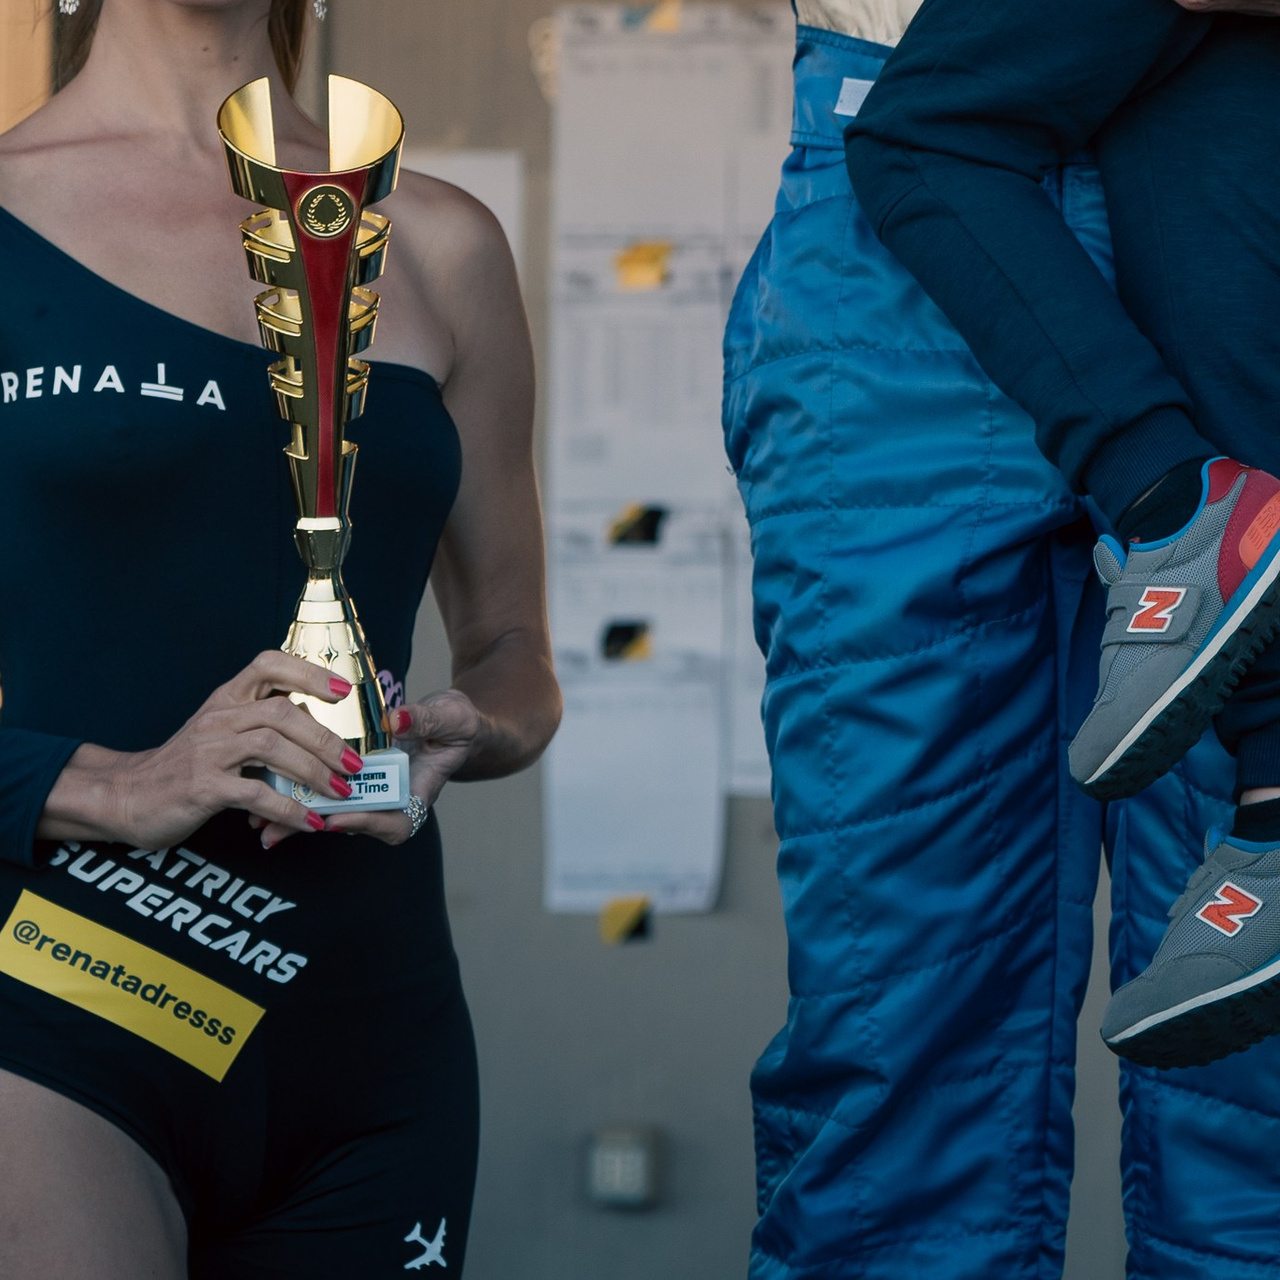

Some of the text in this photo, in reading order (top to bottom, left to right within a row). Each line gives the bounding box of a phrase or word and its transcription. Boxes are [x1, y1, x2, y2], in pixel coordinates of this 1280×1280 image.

[356, 781, 389, 794] Time
[363, 772, 387, 780] CENTER
[49, 840, 308, 984] SUPERCARS
[127, 846, 297, 923] ATRICY
[13, 920, 236, 1046] @renatadresss
